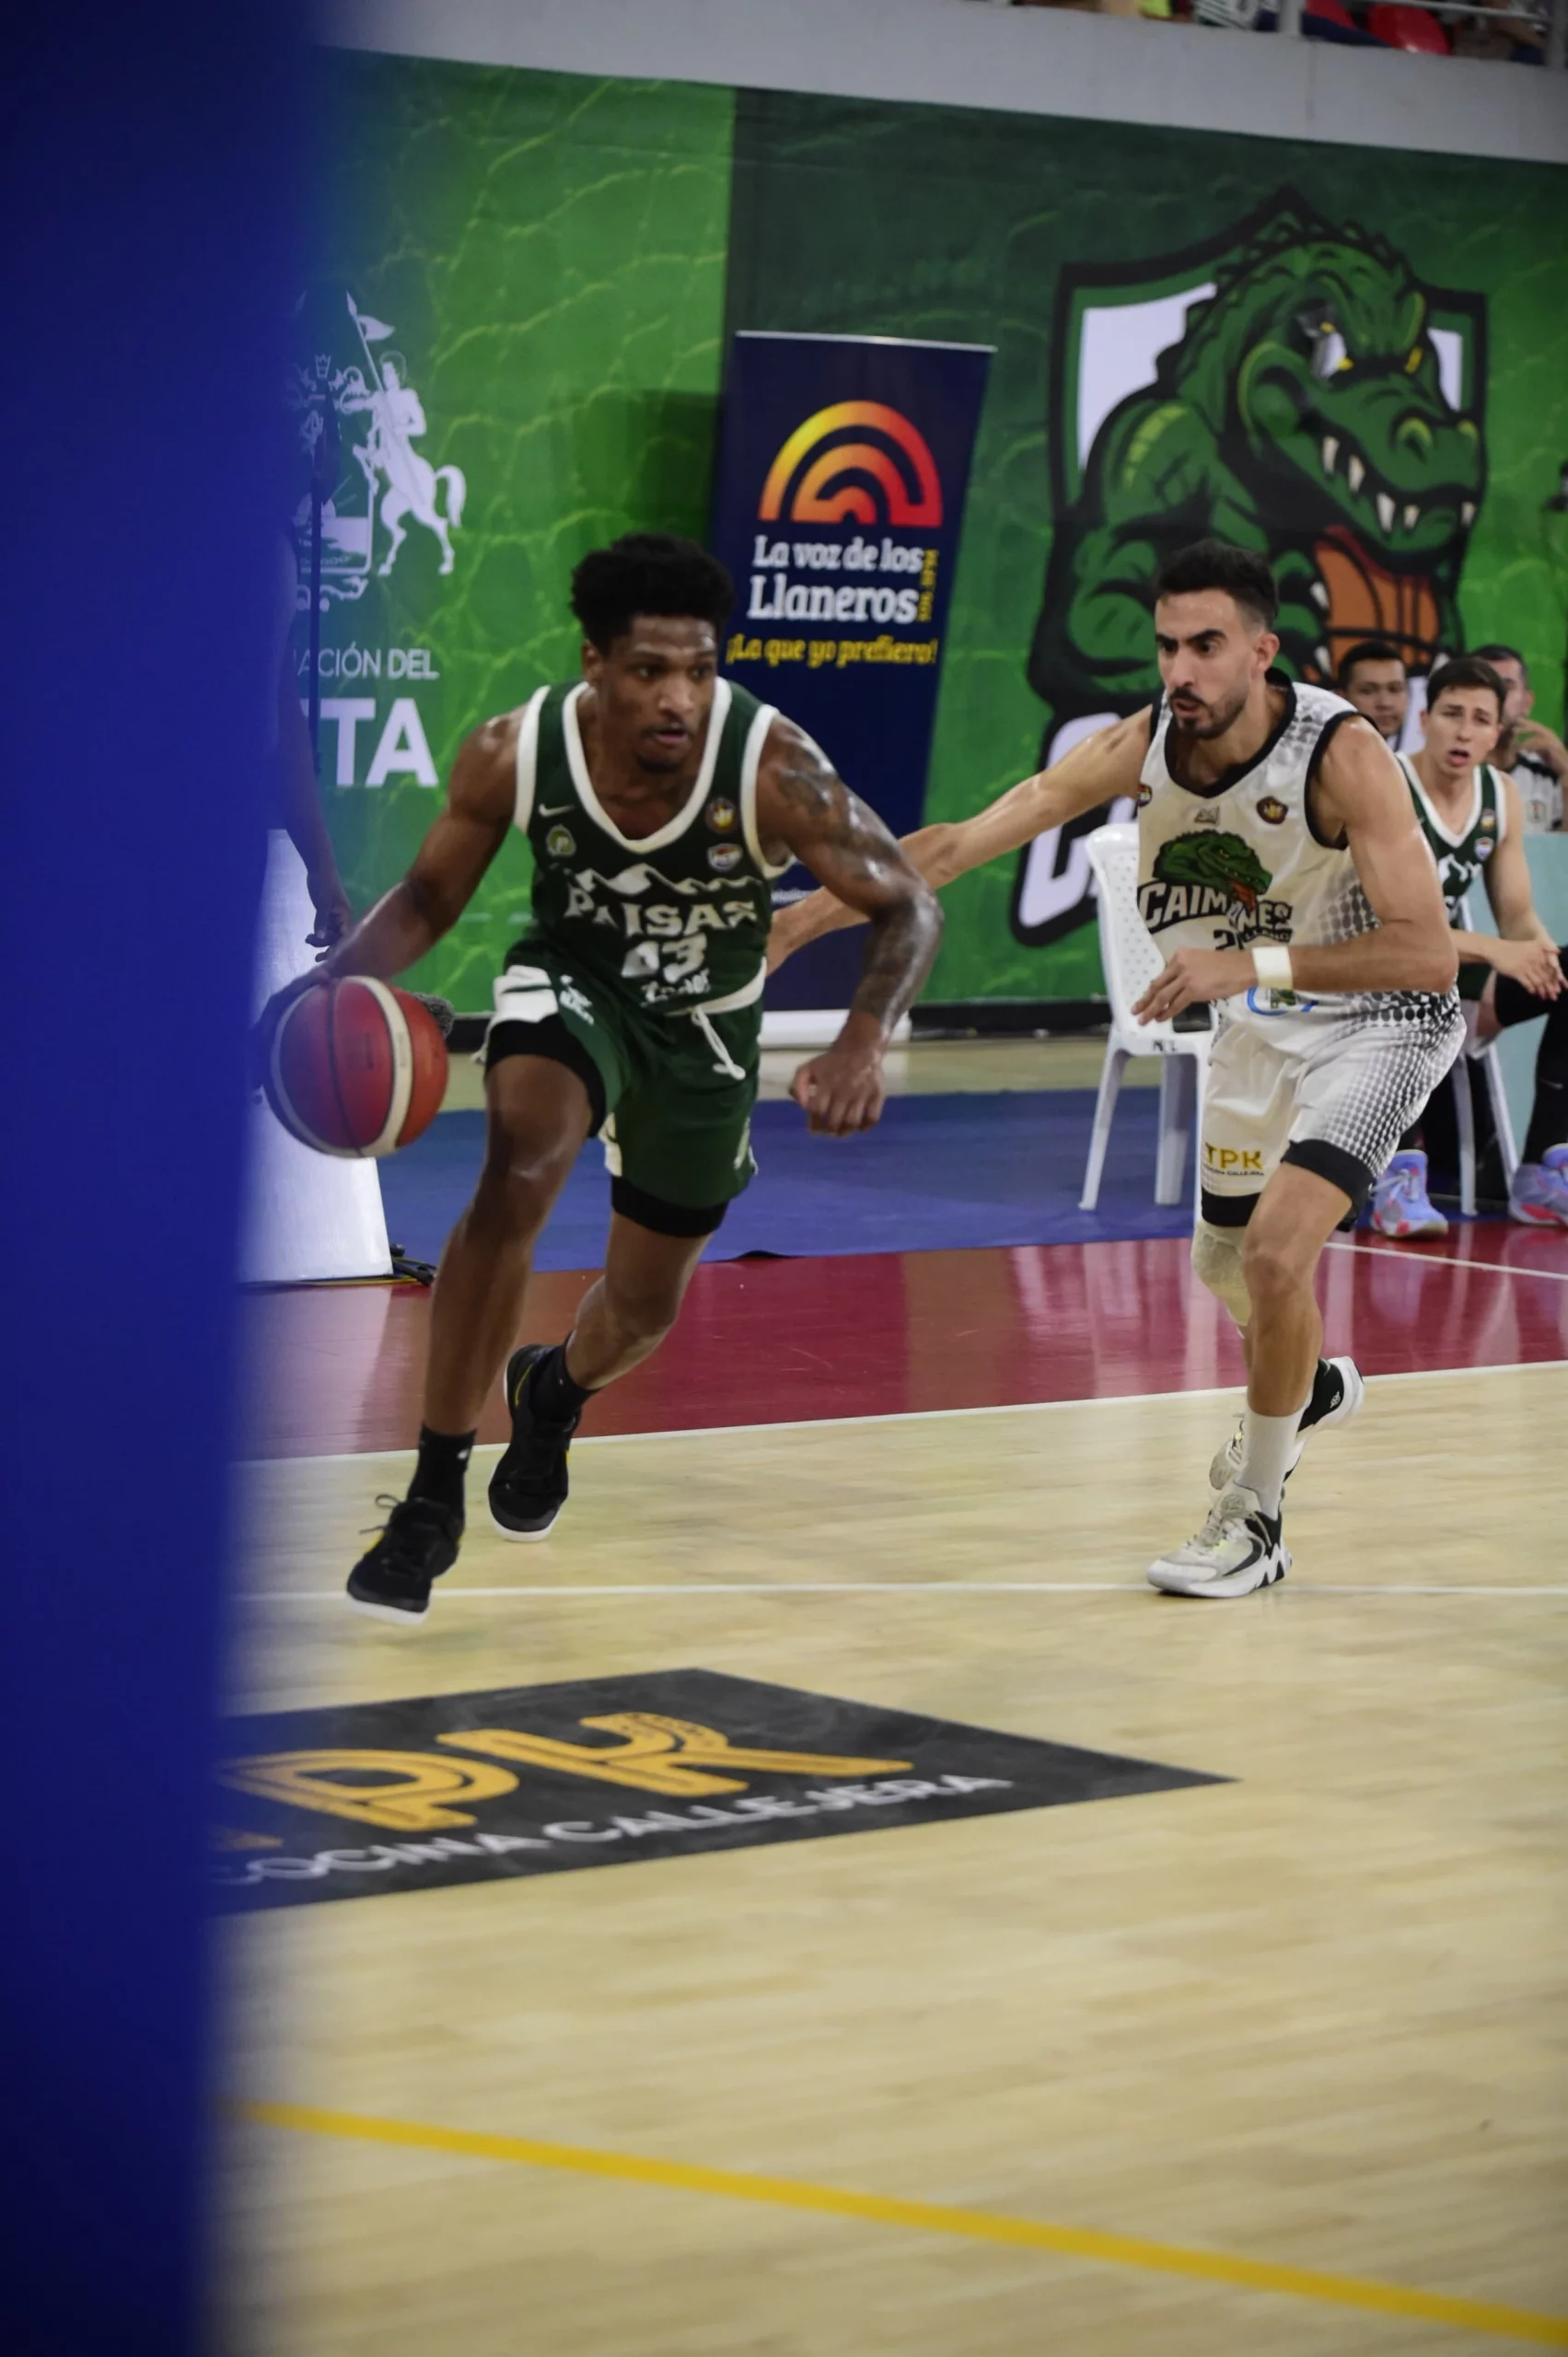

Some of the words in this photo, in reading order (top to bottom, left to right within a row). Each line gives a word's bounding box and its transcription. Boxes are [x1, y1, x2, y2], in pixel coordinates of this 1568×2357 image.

[752, 534, 790, 569] La
[792, 541, 842, 570] voz
[842, 536, 878, 572] de
[878, 537, 923, 574] los
[747, 573, 919, 624] Llaneros
[294, 641, 381, 679] ACIÓN
[387, 648, 440, 679] DEL
[764, 638, 806, 668] que
[807, 641, 837, 668] yo
[836, 634, 938, 668] prefiero!
[299, 697, 439, 788] TA
[1204, 1142, 1263, 1170] TPK
[215, 1711, 914, 1849] PK
